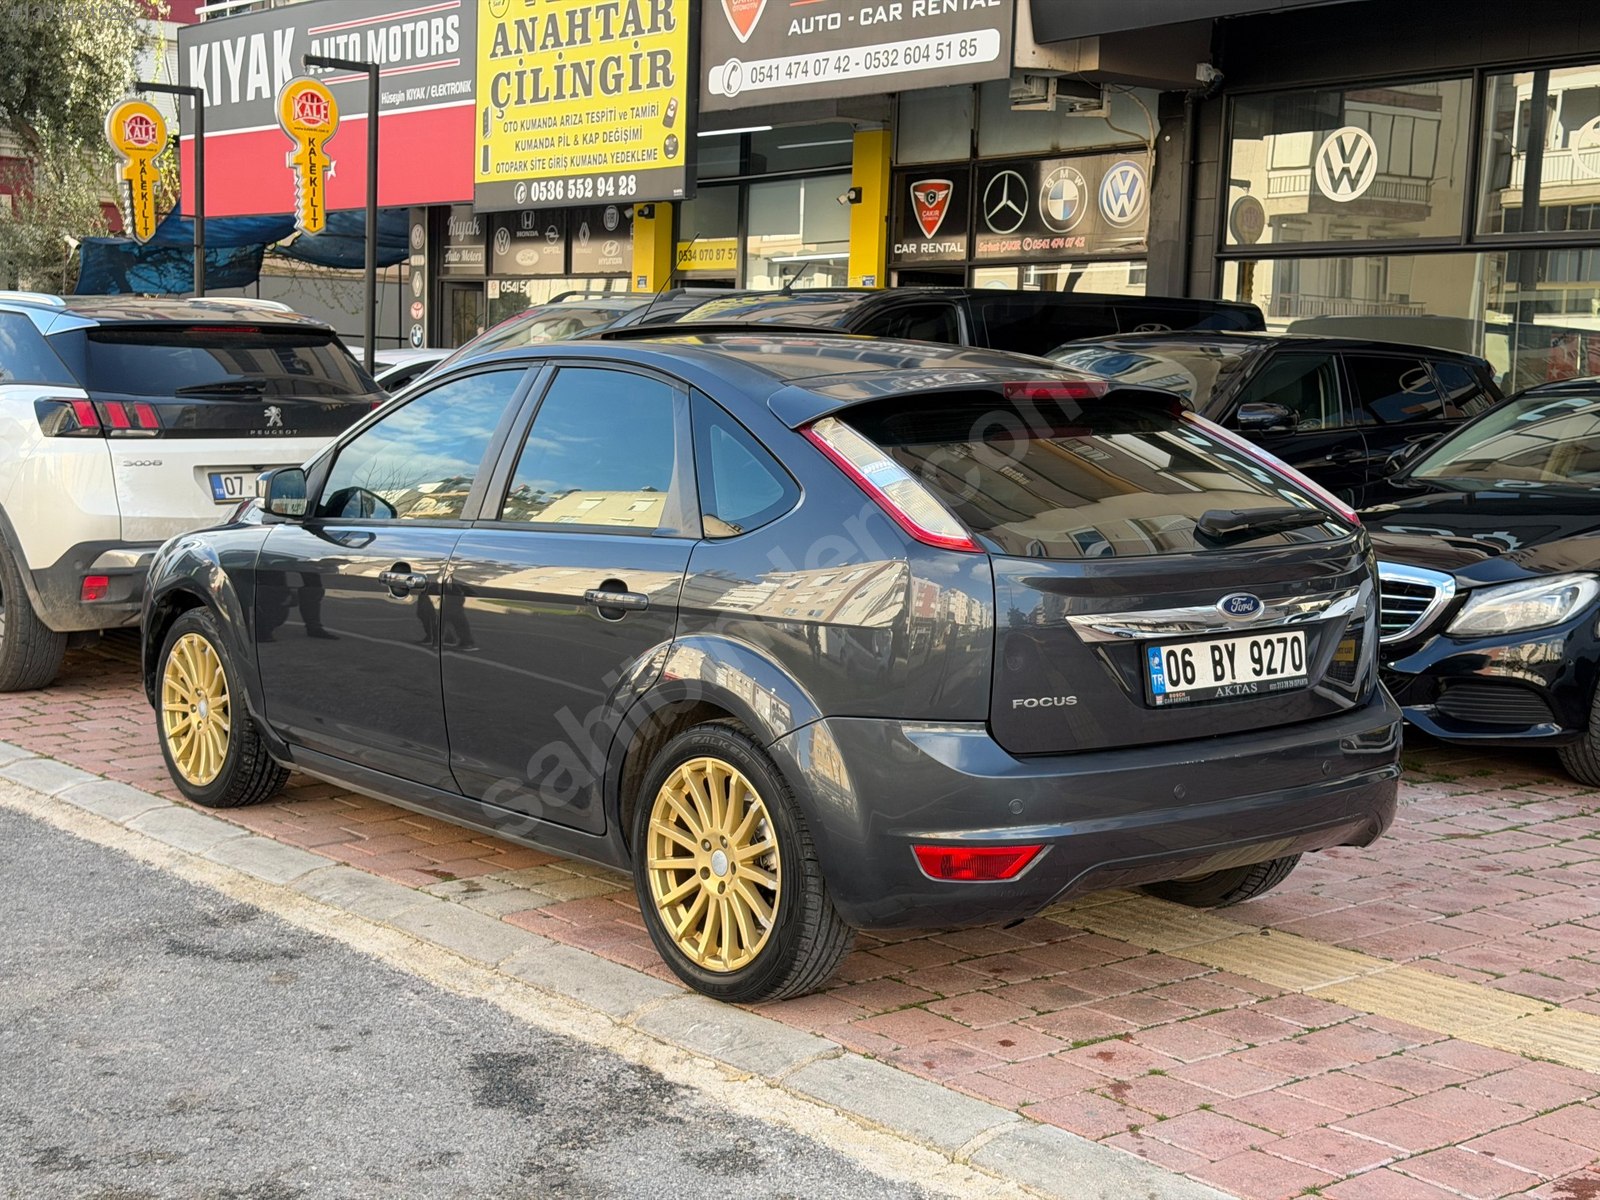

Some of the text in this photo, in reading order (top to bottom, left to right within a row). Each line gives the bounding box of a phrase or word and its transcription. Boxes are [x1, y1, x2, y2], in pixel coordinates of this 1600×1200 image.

[489, 0, 676, 59] ANAHTAR
[788, 13, 841, 36] AUTO
[860, 3, 903, 26] CAR
[309, 15, 460, 75] AUTO MOTORS
[189, 27, 295, 109] KIYAK
[750, 63, 780, 84] 0541
[785, 60, 809, 79] 474
[813, 58, 830, 76] 07
[833, 55, 850, 73] 42
[864, 48, 899, 70] 0532
[903, 44, 931, 65] 604
[936, 41, 953, 61] 51
[959, 38, 978, 57] 85
[491, 40, 675, 119] ÇİLİNGİR
[406, 87, 426, 101] KIYAK
[293, 97, 329, 122] KALE
[503, 103, 660, 133] OTO KUMANDA ARIZA TESPİTİ ve TAMİRİ
[125, 120, 157, 142] KALE
[515, 125, 643, 152] KUMANDA PİL & KAP DEĞİŞİMİ
[495, 148, 658, 174] OTOPARK SİTE GİRİŞ KUMANDA YEDEKLEME
[531, 174, 637, 202] 0536 552 94 28
[516, 230, 539, 238] HONDA
[679, 247, 738, 262] 0534 070 87 57
[894, 242, 964, 254] CAR RENTAL
[501, 281, 518, 293] 0541
[224, 476, 243, 496] 07
[1230, 596, 1257, 613] Ford
[1165, 634, 1303, 689] 06 BY 9270
[1152, 674, 1164, 686] TR
[1215, 682, 1258, 698] AKTAS
[1012, 695, 1078, 709] FOCUS
